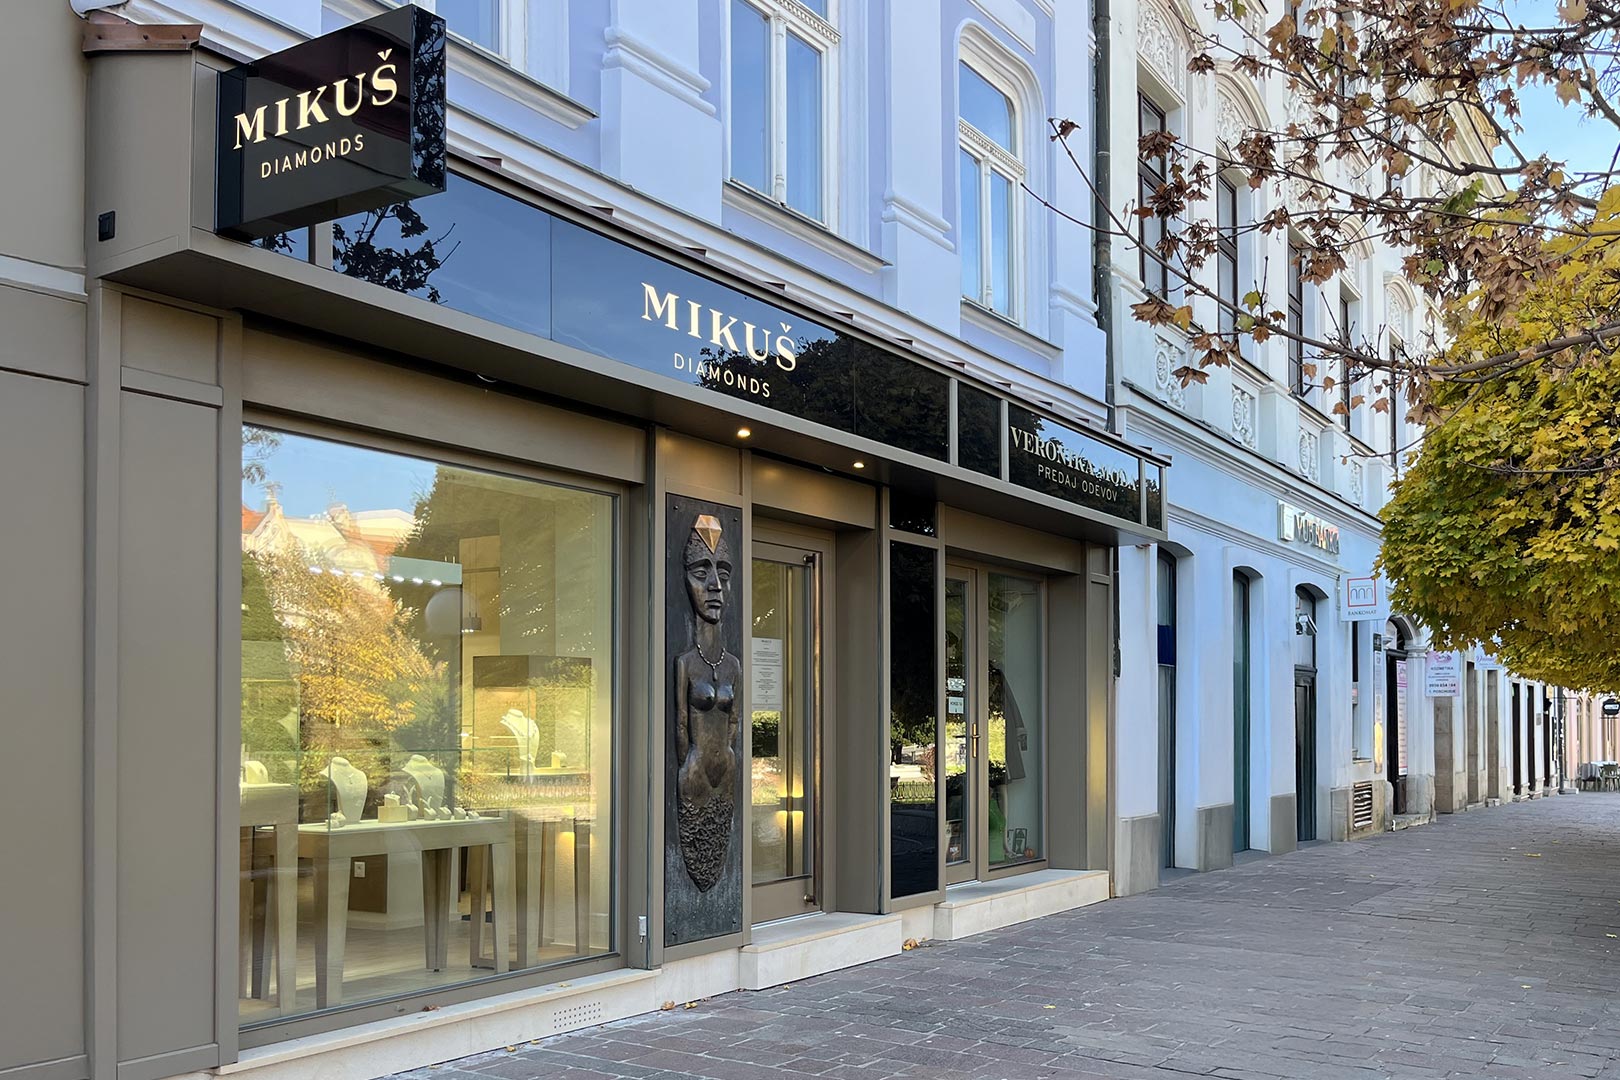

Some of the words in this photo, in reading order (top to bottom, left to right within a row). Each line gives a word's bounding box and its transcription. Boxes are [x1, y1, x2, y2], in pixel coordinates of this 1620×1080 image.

[233, 49, 397, 149] MIKUŠ
[261, 134, 364, 178] DIAMONDS
[641, 282, 796, 371] MIKUŠ
[674, 352, 770, 398] DIAMONDS
[1037, 464, 1077, 489] PREDAJ
[1081, 480, 1118, 502] ODEVOV
